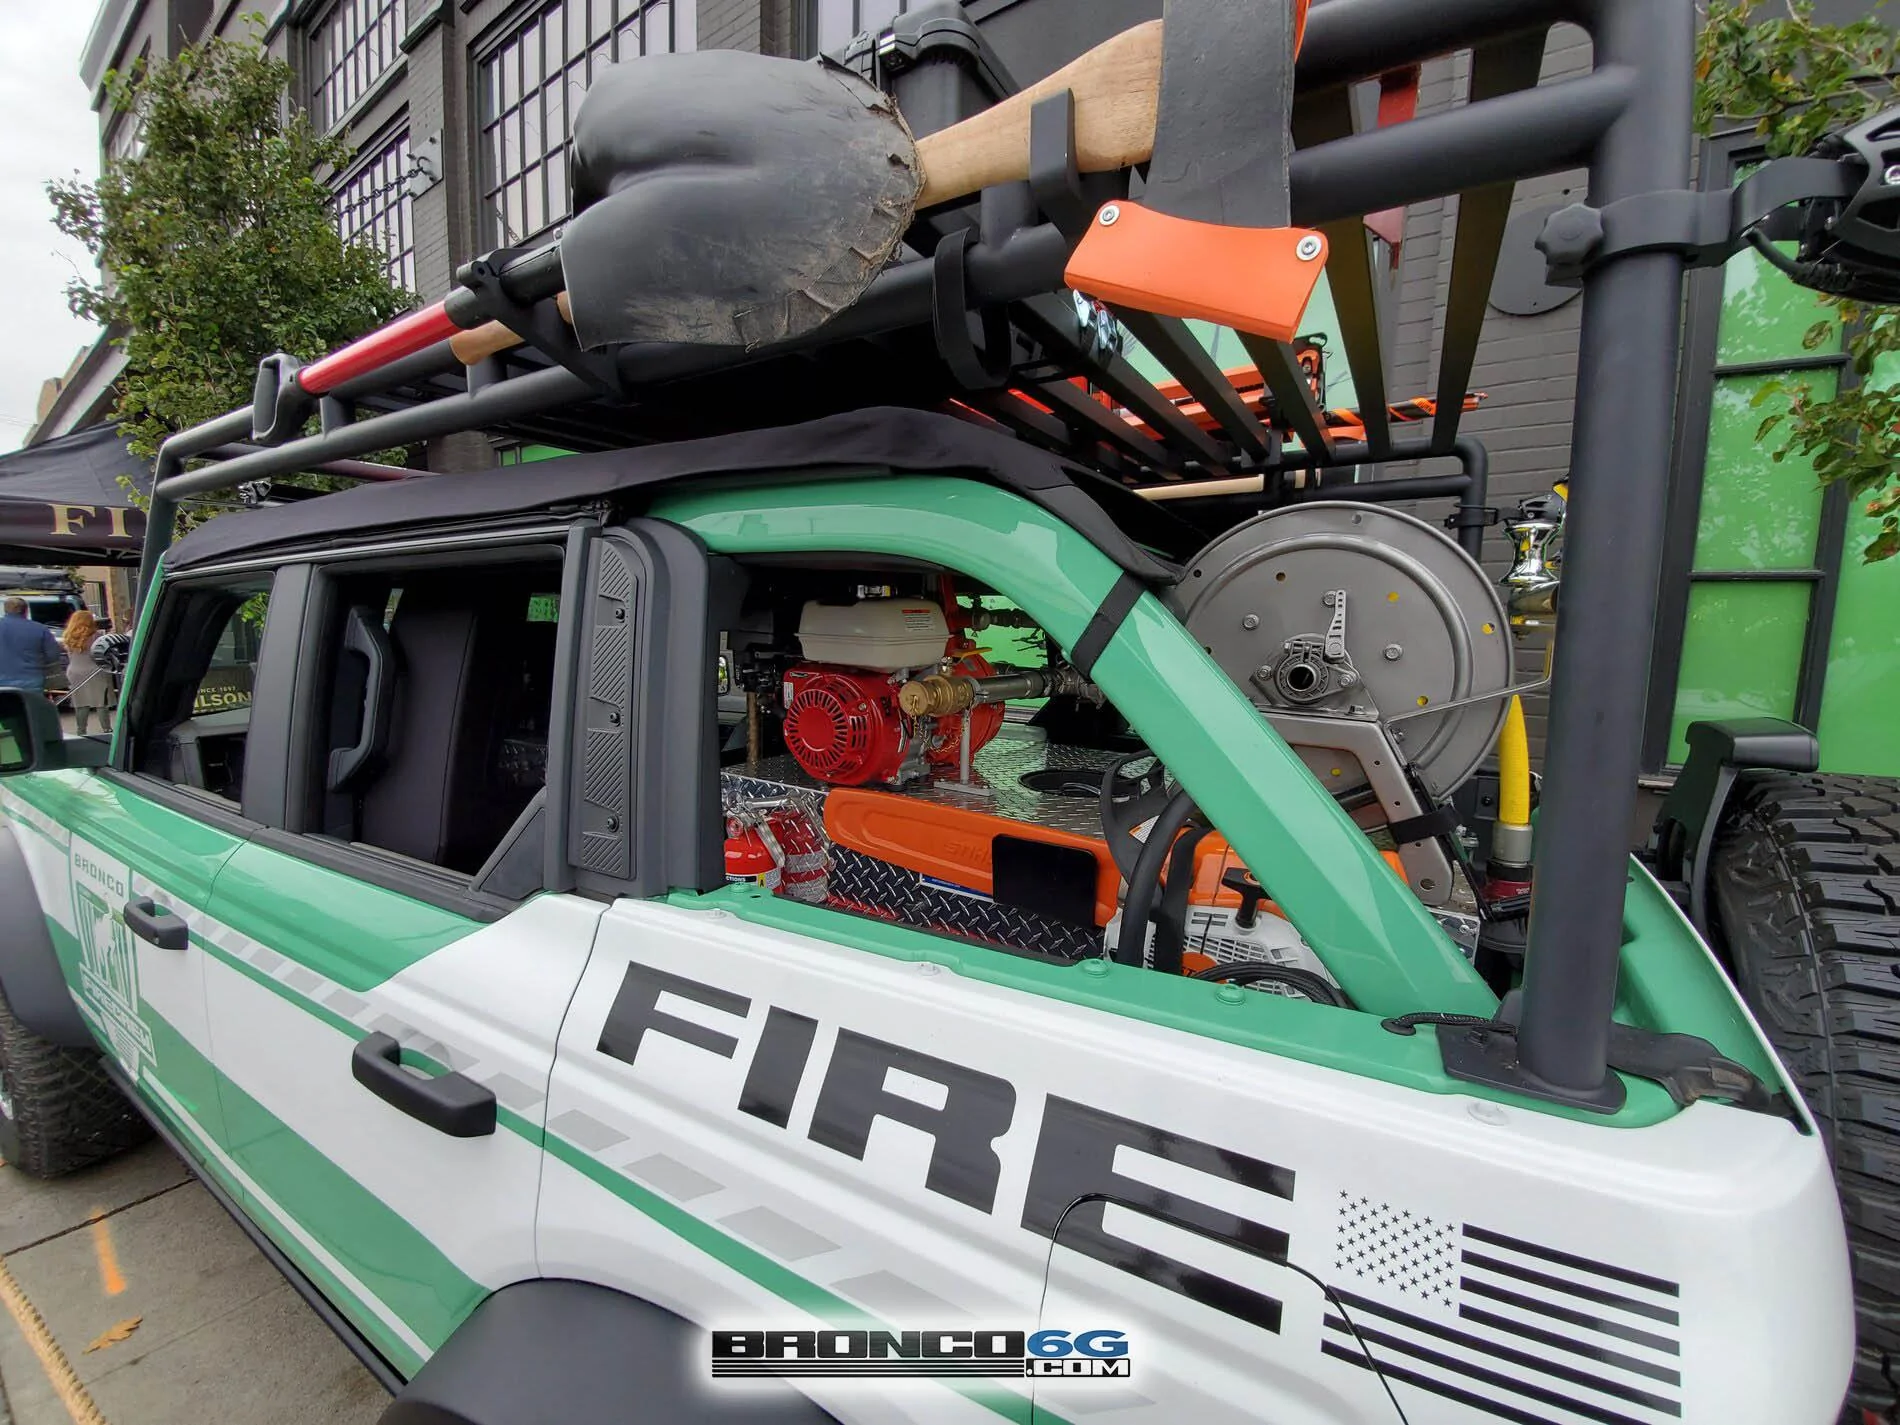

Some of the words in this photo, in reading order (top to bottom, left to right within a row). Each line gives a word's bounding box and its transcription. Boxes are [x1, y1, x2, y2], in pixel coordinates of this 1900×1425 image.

[47, 503, 149, 538] FI
[74, 852, 125, 898] BRONCO
[596, 961, 1296, 1335] FIRE
